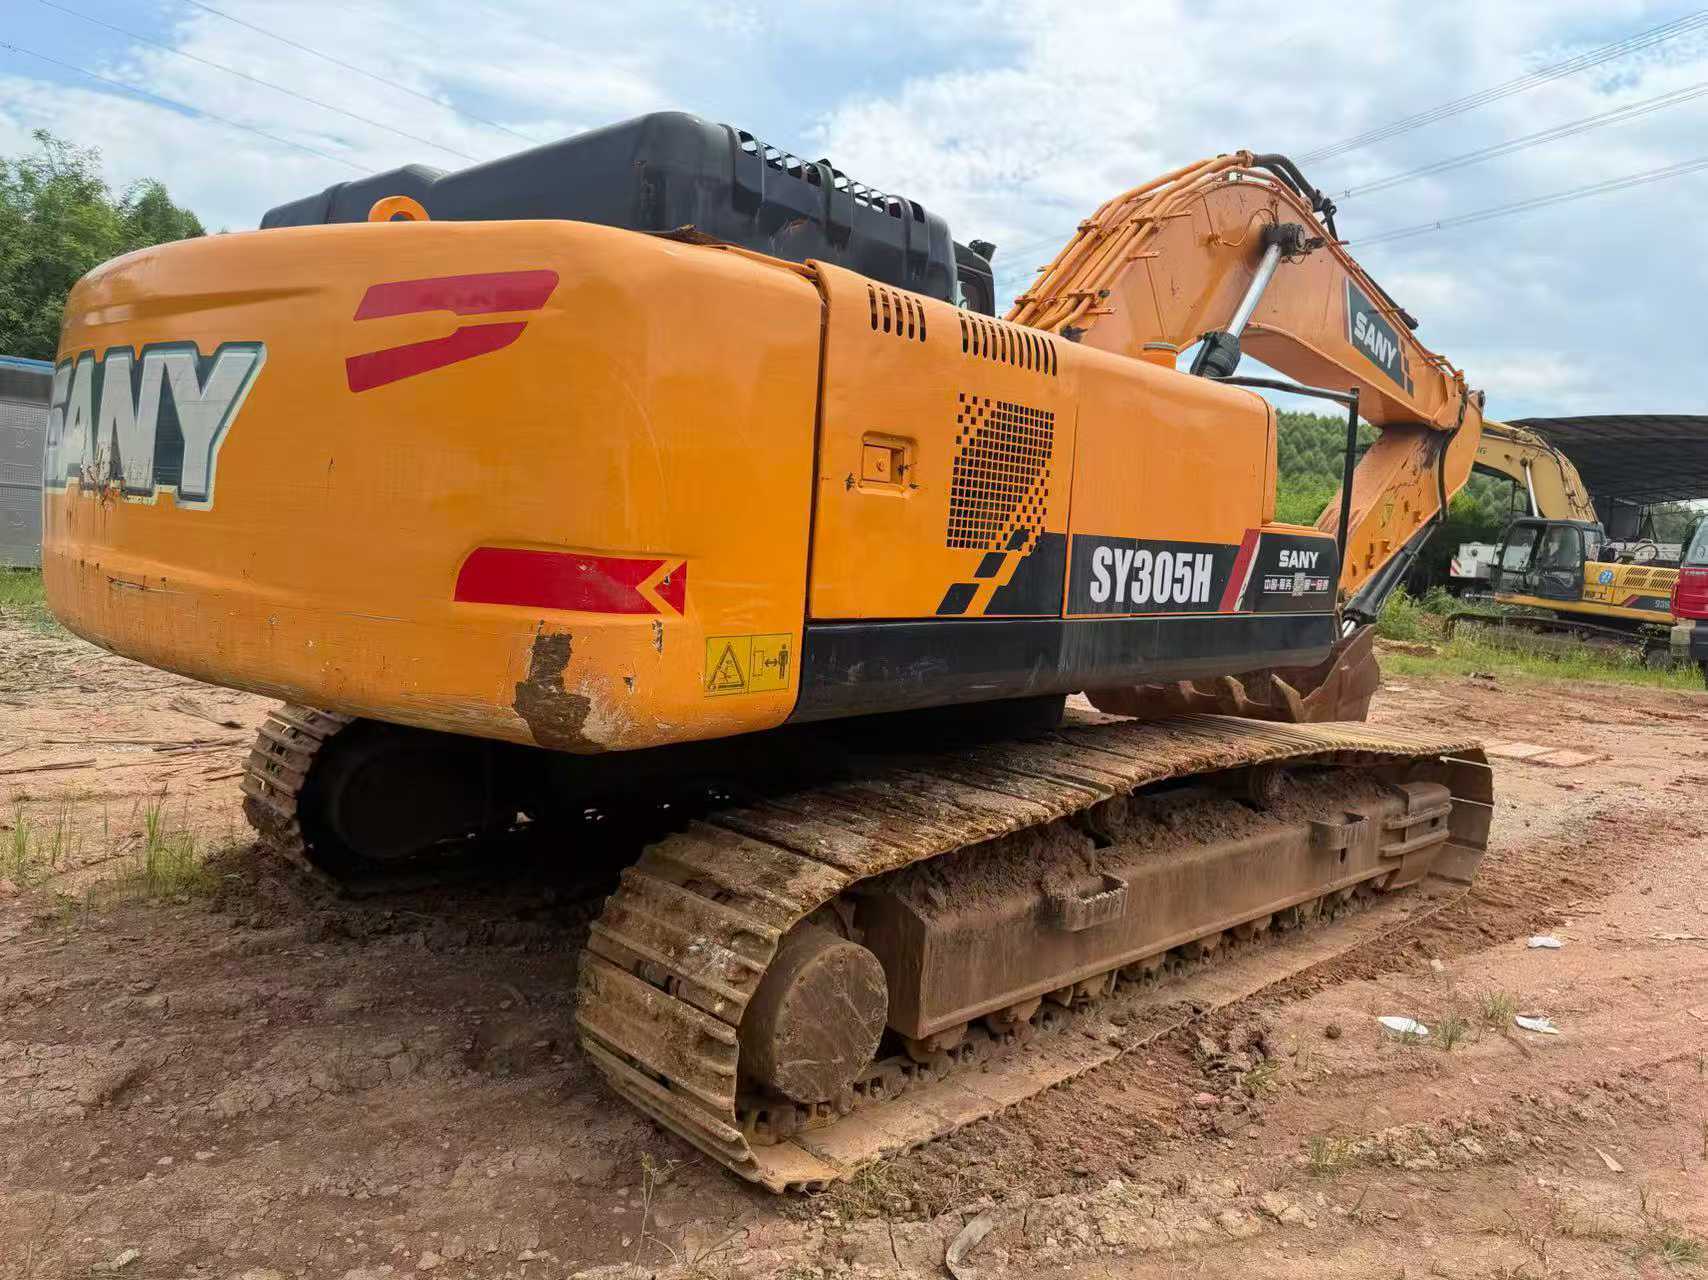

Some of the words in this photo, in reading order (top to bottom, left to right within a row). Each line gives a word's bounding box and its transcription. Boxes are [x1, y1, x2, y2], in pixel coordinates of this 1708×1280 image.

[1353, 312, 1397, 368] SANY
[1090, 546, 1213, 604] SY305H
[1279, 550, 1319, 568] SANY
